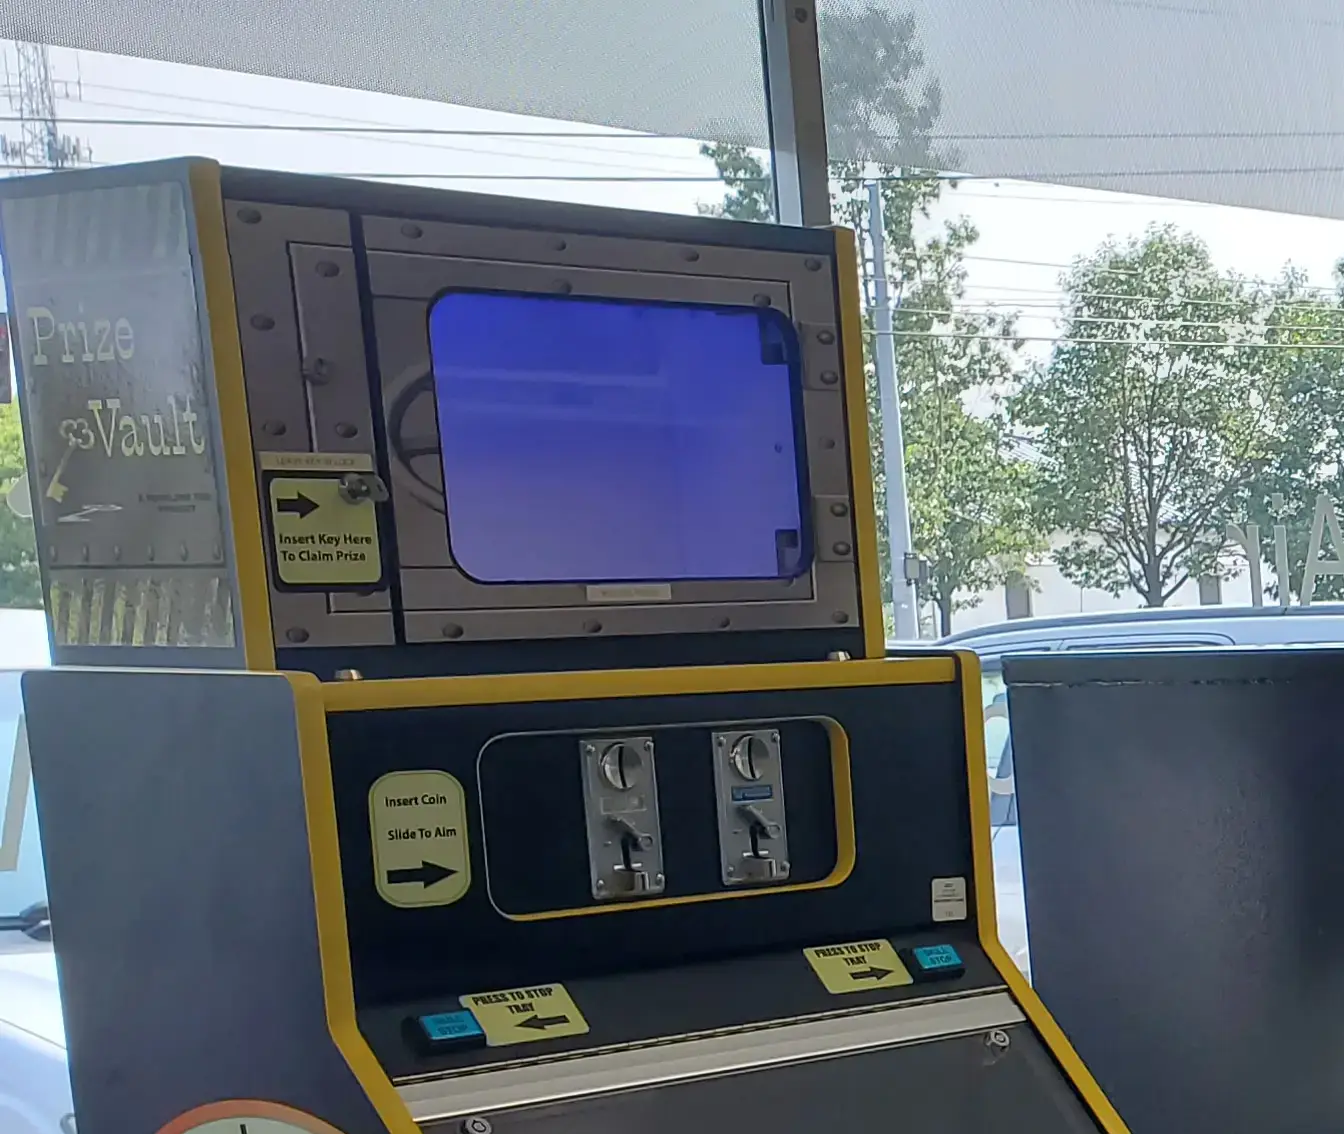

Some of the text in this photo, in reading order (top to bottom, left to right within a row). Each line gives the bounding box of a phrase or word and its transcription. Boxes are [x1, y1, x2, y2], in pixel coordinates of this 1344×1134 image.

[27, 307, 135, 365] Prize
[88, 395, 205, 457] Vault
[279, 533, 372, 547] Insert Key Here
[280, 551, 366, 562] To Claim Prize
[385, 794, 447, 807] Insert Coin
[388, 827, 457, 840] Slide To Aim
[814, 942, 882, 959] PRESS TO STOP
[842, 955, 868, 967] TRAY
[471, 987, 554, 1006] PRESS TO STOP
[505, 1002, 535, 1015] TRAY
